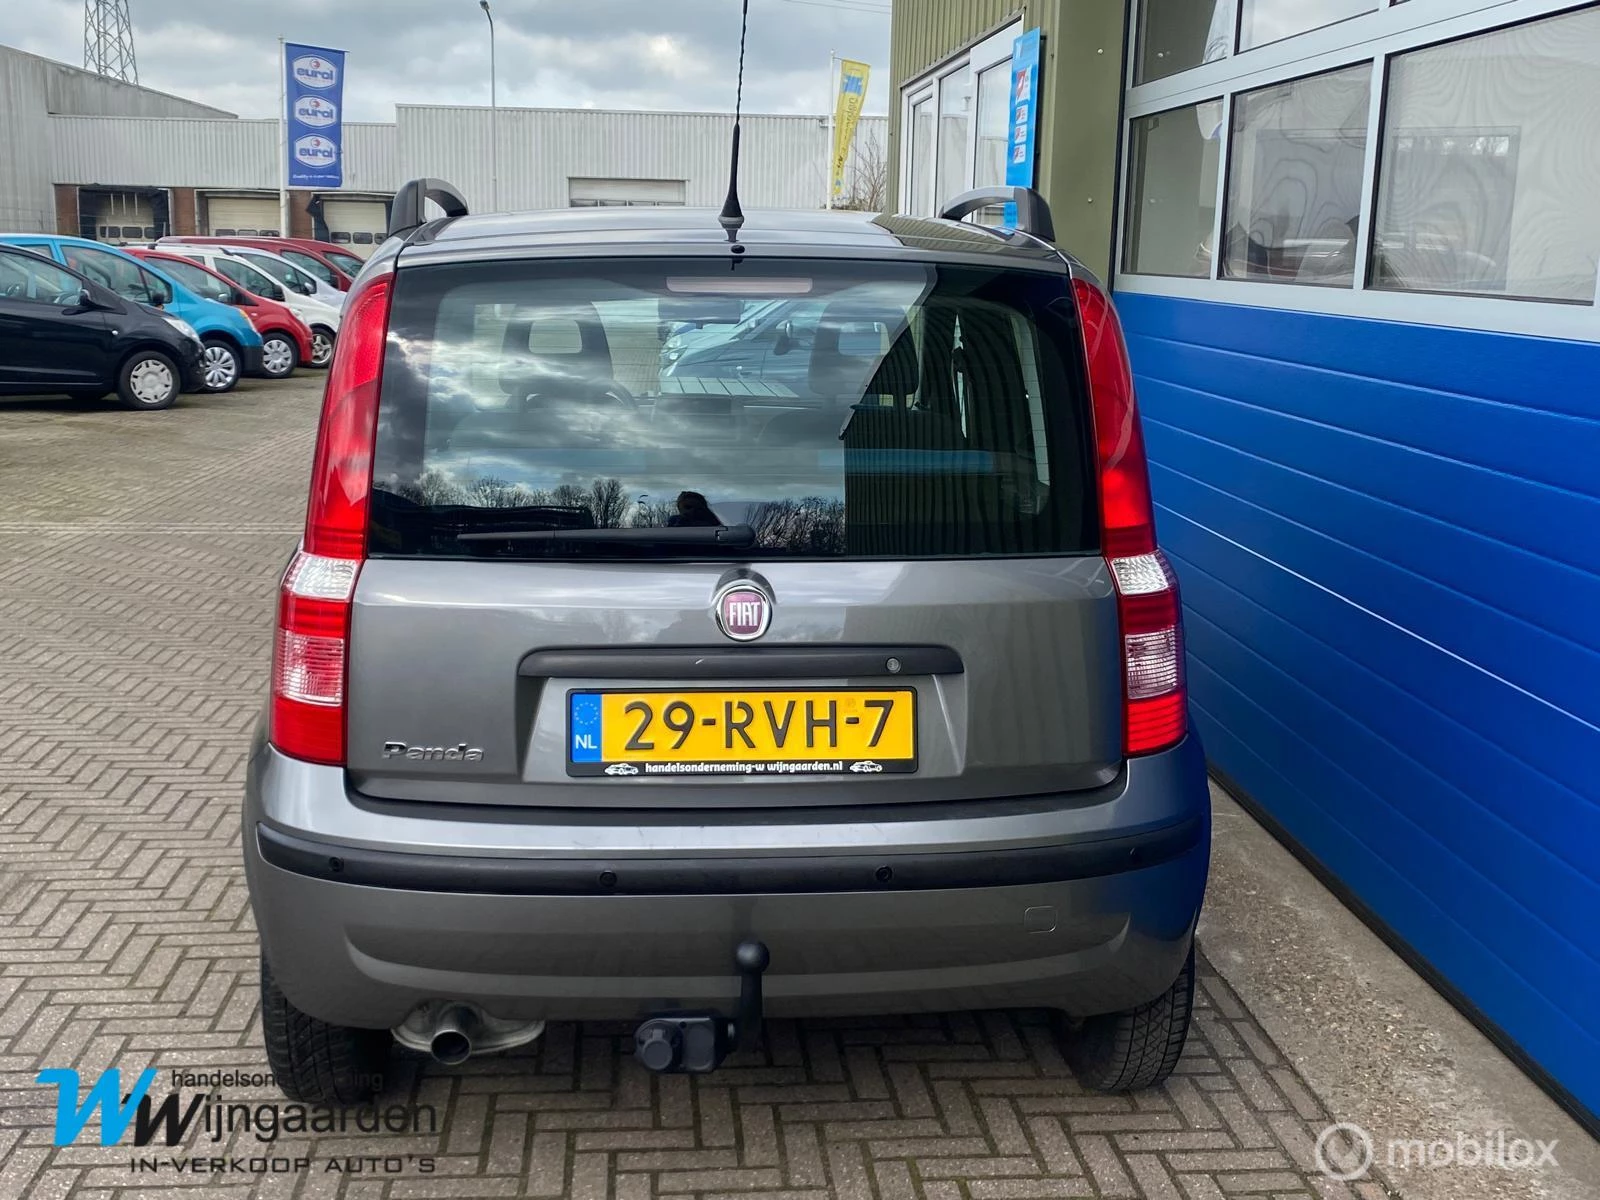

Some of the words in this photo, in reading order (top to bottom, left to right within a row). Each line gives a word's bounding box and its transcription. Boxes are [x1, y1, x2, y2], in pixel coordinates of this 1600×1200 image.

[297, 67, 334, 81] eurol
[298, 106, 334, 119] eurol
[298, 146, 333, 158] eurol
[729, 601, 761, 627] FIAT
[624, 700, 894, 750] 29-RVH-7
[575, 734, 597, 749] NL
[382, 741, 484, 761] Panda
[767, 761, 843, 774] wijngaarden.nl
